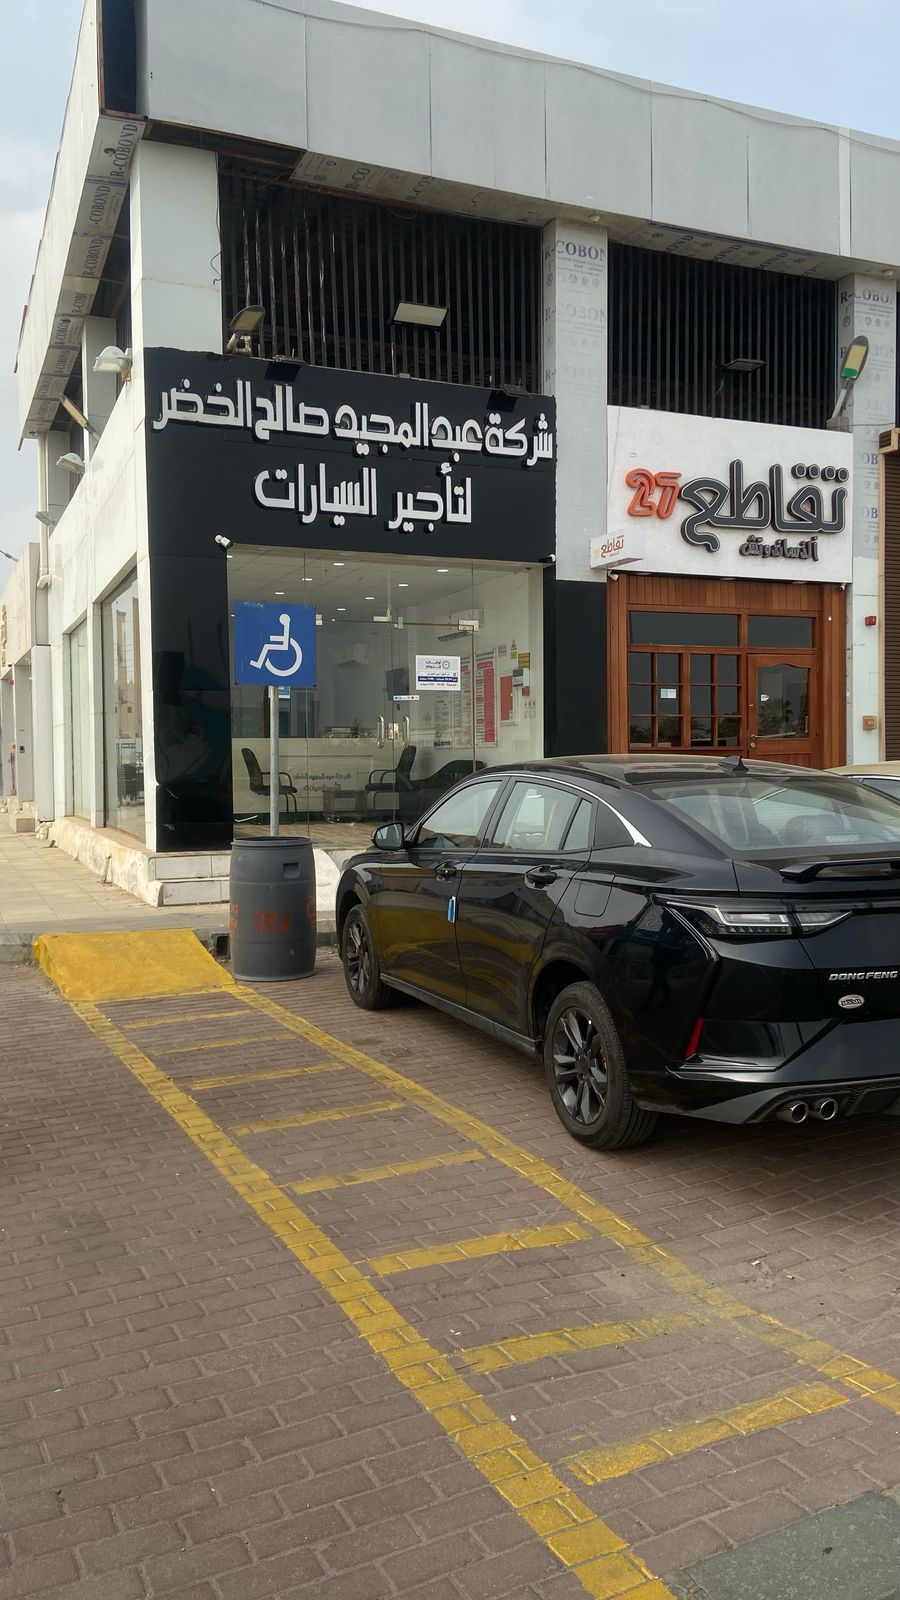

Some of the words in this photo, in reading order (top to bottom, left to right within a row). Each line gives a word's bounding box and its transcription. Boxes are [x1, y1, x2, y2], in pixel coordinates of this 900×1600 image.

[110, 123, 139, 178] R-COBOND
[88, 185, 112, 231] -COBOND
[152, 378, 253, 431] الخضر
[254, 384, 330, 441] صالح
[334, 402, 430, 456] المجيد
[430, 415, 484, 463] عبد
[483, 412, 553, 467] شركة
[254, 462, 378, 527] السيارات
[388, 462, 472, 533] لتأجير
[625, 467, 682, 520] 27
[679, 459, 850, 553] تقاطع
[828, 970, 898, 981] DONGFENG
